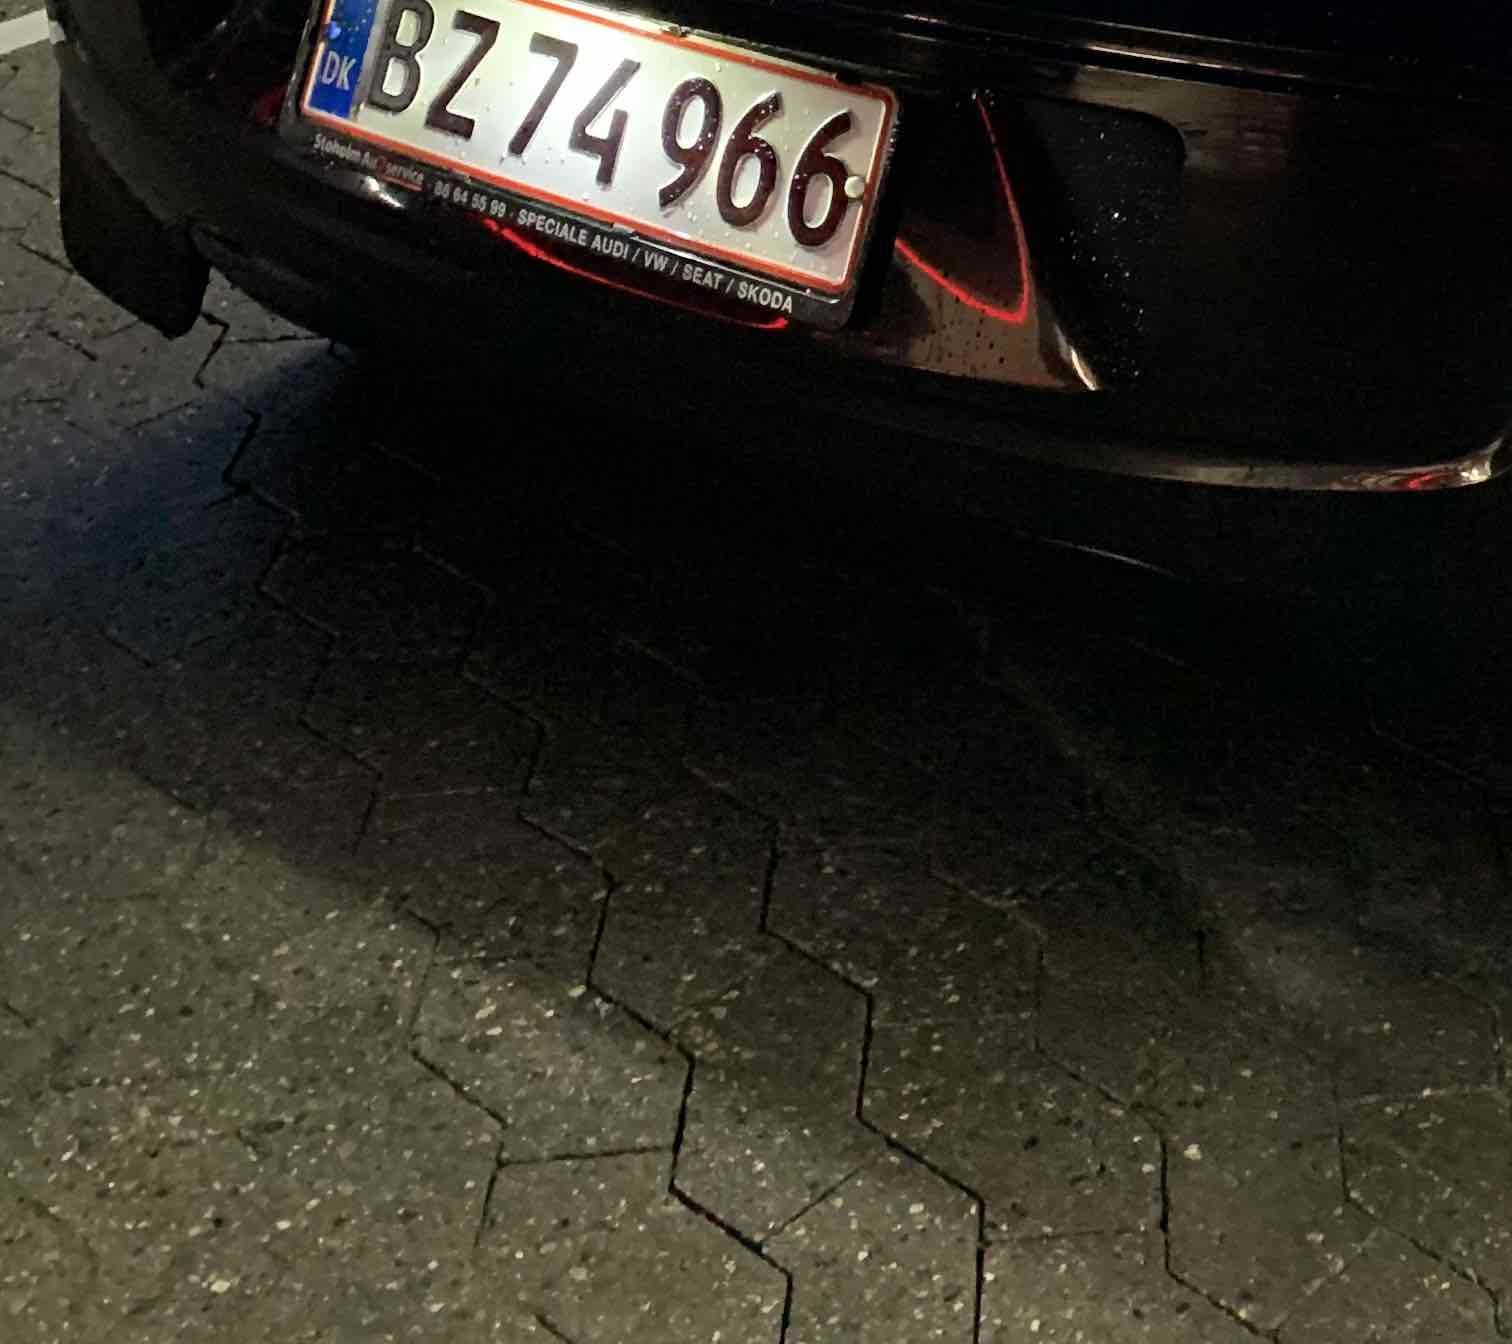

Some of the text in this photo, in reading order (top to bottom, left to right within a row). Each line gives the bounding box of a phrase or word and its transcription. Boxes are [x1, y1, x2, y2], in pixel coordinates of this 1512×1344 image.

[320, 50, 355, 90] DK
[516, 207, 588, 247] SPECIALE
[590, 232, 629, 260] AUDI
[642, 249, 669, 273] VW
[681, 262, 724, 291] SEAT
